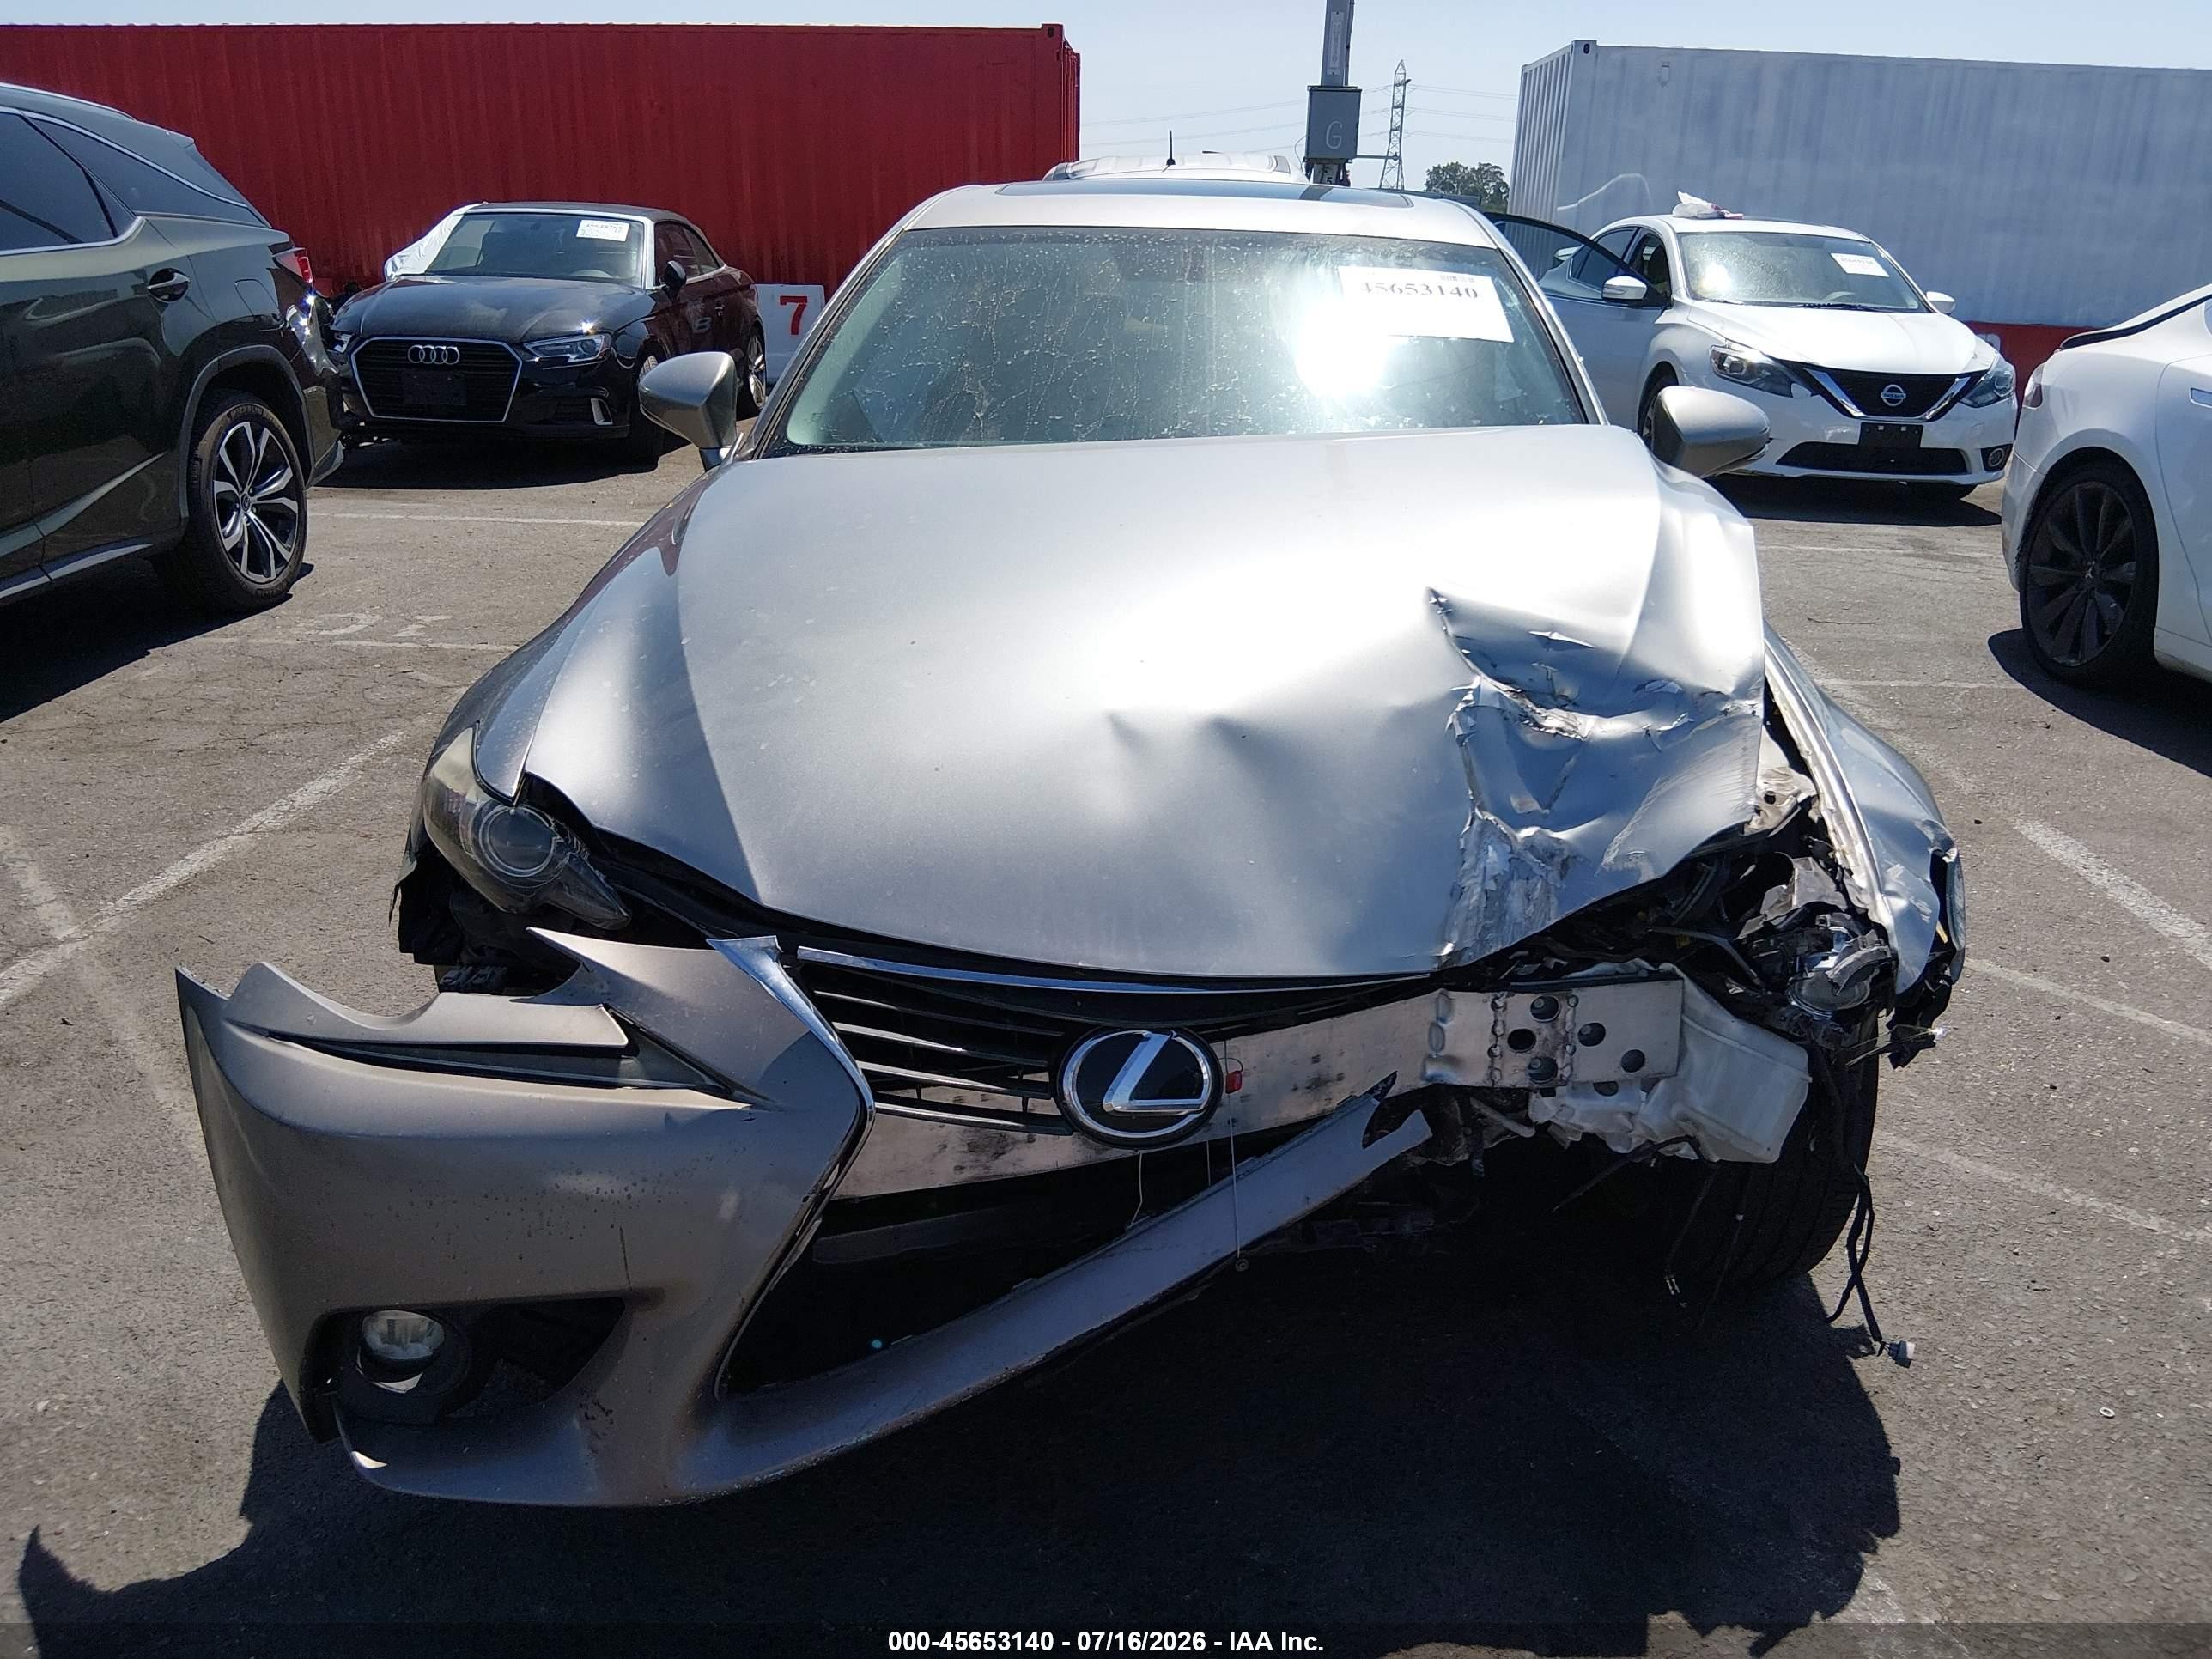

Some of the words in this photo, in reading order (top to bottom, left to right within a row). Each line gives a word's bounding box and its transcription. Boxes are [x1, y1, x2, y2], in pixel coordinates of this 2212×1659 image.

[1326, 121, 1343, 149] G
[1362, 281, 1478, 299] 45653140
[780, 295, 807, 335] 7
